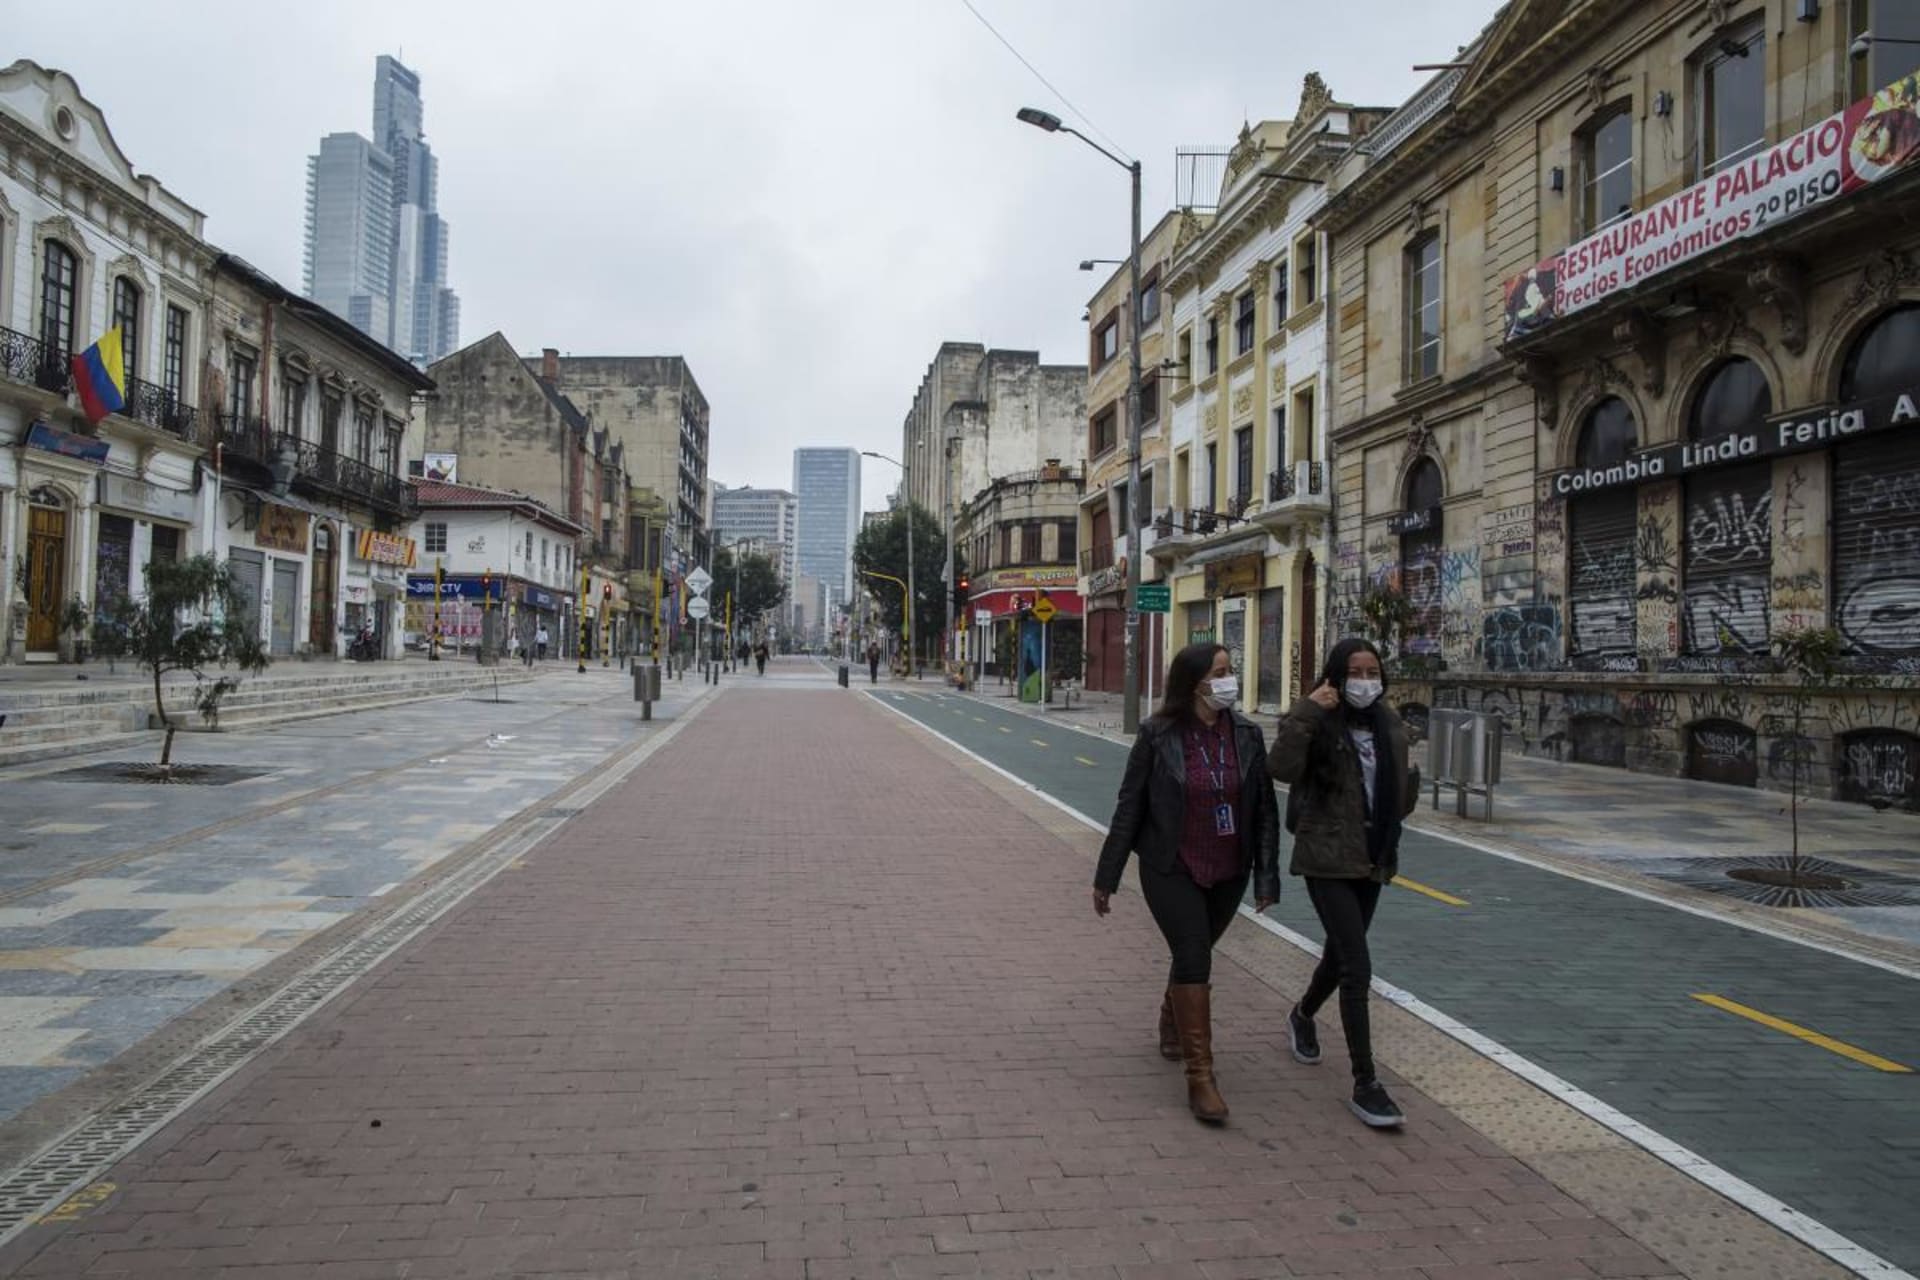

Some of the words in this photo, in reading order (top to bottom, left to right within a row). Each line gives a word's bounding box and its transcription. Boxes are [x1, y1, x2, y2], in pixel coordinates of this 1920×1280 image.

[1556, 186, 1707, 284] RESTAURANTE
[1715, 119, 1843, 209] PALACIO
[1556, 268, 1618, 315] Precios
[1624, 208, 1751, 282] Económicos
[1785, 168, 1841, 214] PISO
[1556, 454, 1665, 494] Colombia
[1682, 433, 1758, 469] Linda
[1778, 409, 1865, 447] Feria
[414, 582, 462, 593] DIRCTV
